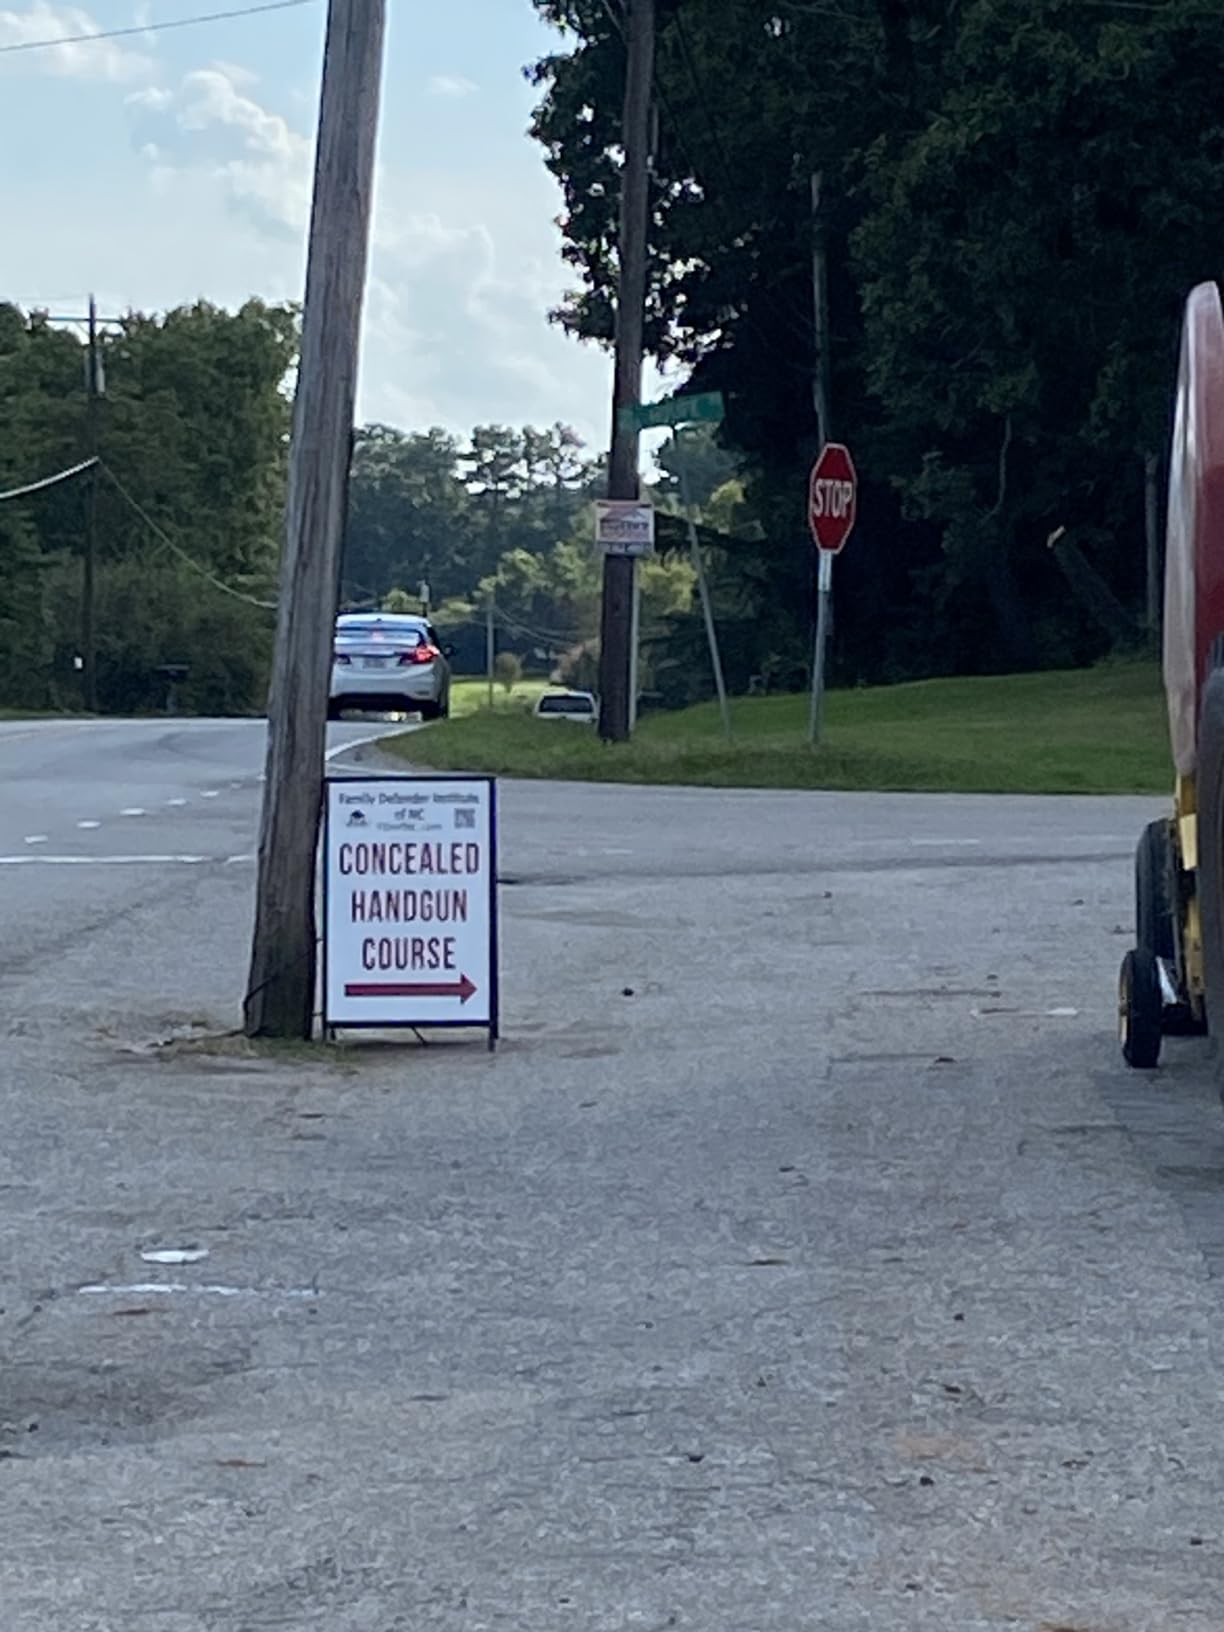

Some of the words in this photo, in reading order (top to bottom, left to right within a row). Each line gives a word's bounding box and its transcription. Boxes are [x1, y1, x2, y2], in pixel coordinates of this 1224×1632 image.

[814, 479, 853, 517] STOP
[339, 793, 375, 805] Family
[378, 793, 429, 804] Defender
[339, 843, 479, 875] CONCEALED
[352, 889, 467, 922] HANDGUN
[362, 937, 456, 970] COURSE
